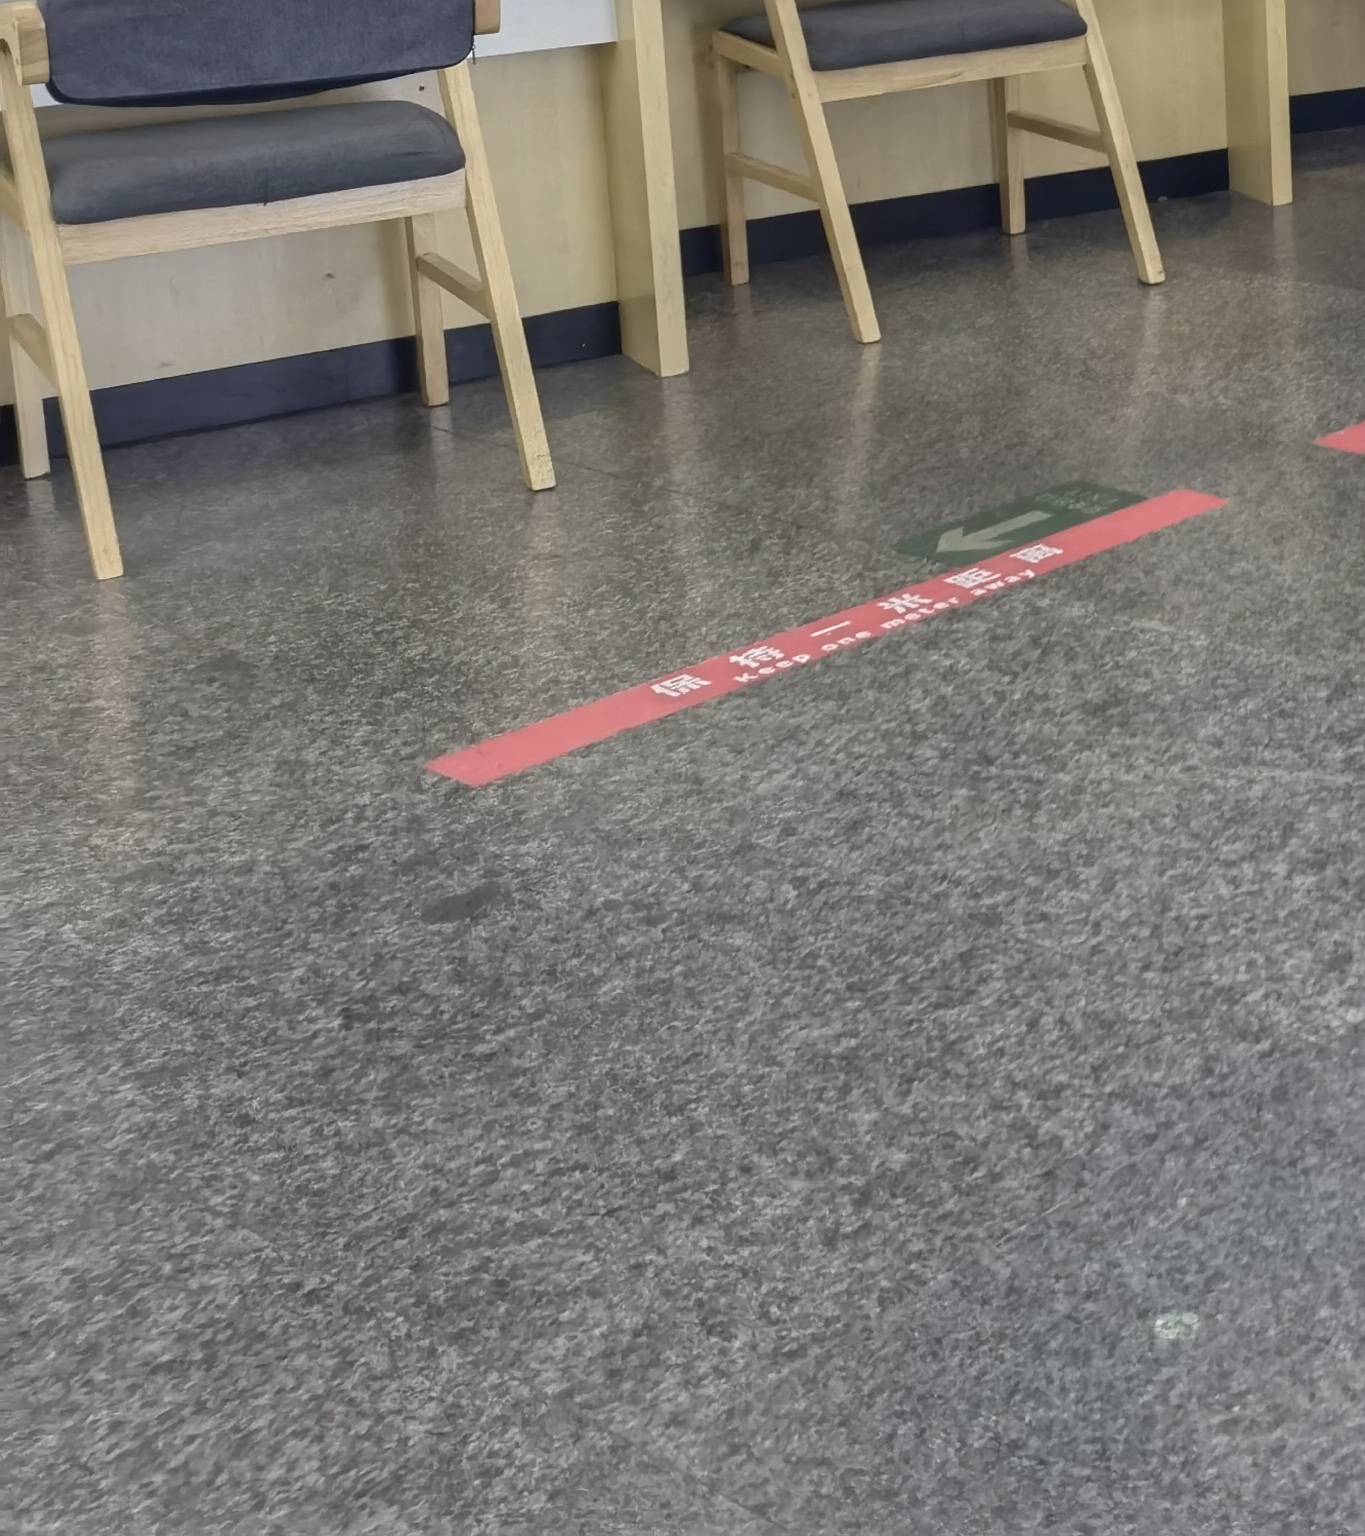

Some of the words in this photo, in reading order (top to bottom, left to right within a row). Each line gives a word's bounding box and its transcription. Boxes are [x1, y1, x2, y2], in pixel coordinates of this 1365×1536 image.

[651, 544, 1063, 697] 保持一米距离
[733, 652, 811, 683] Keep
[820, 630, 872, 652] one
[880, 596, 960, 630] meter
[970, 568, 1037, 597] away
